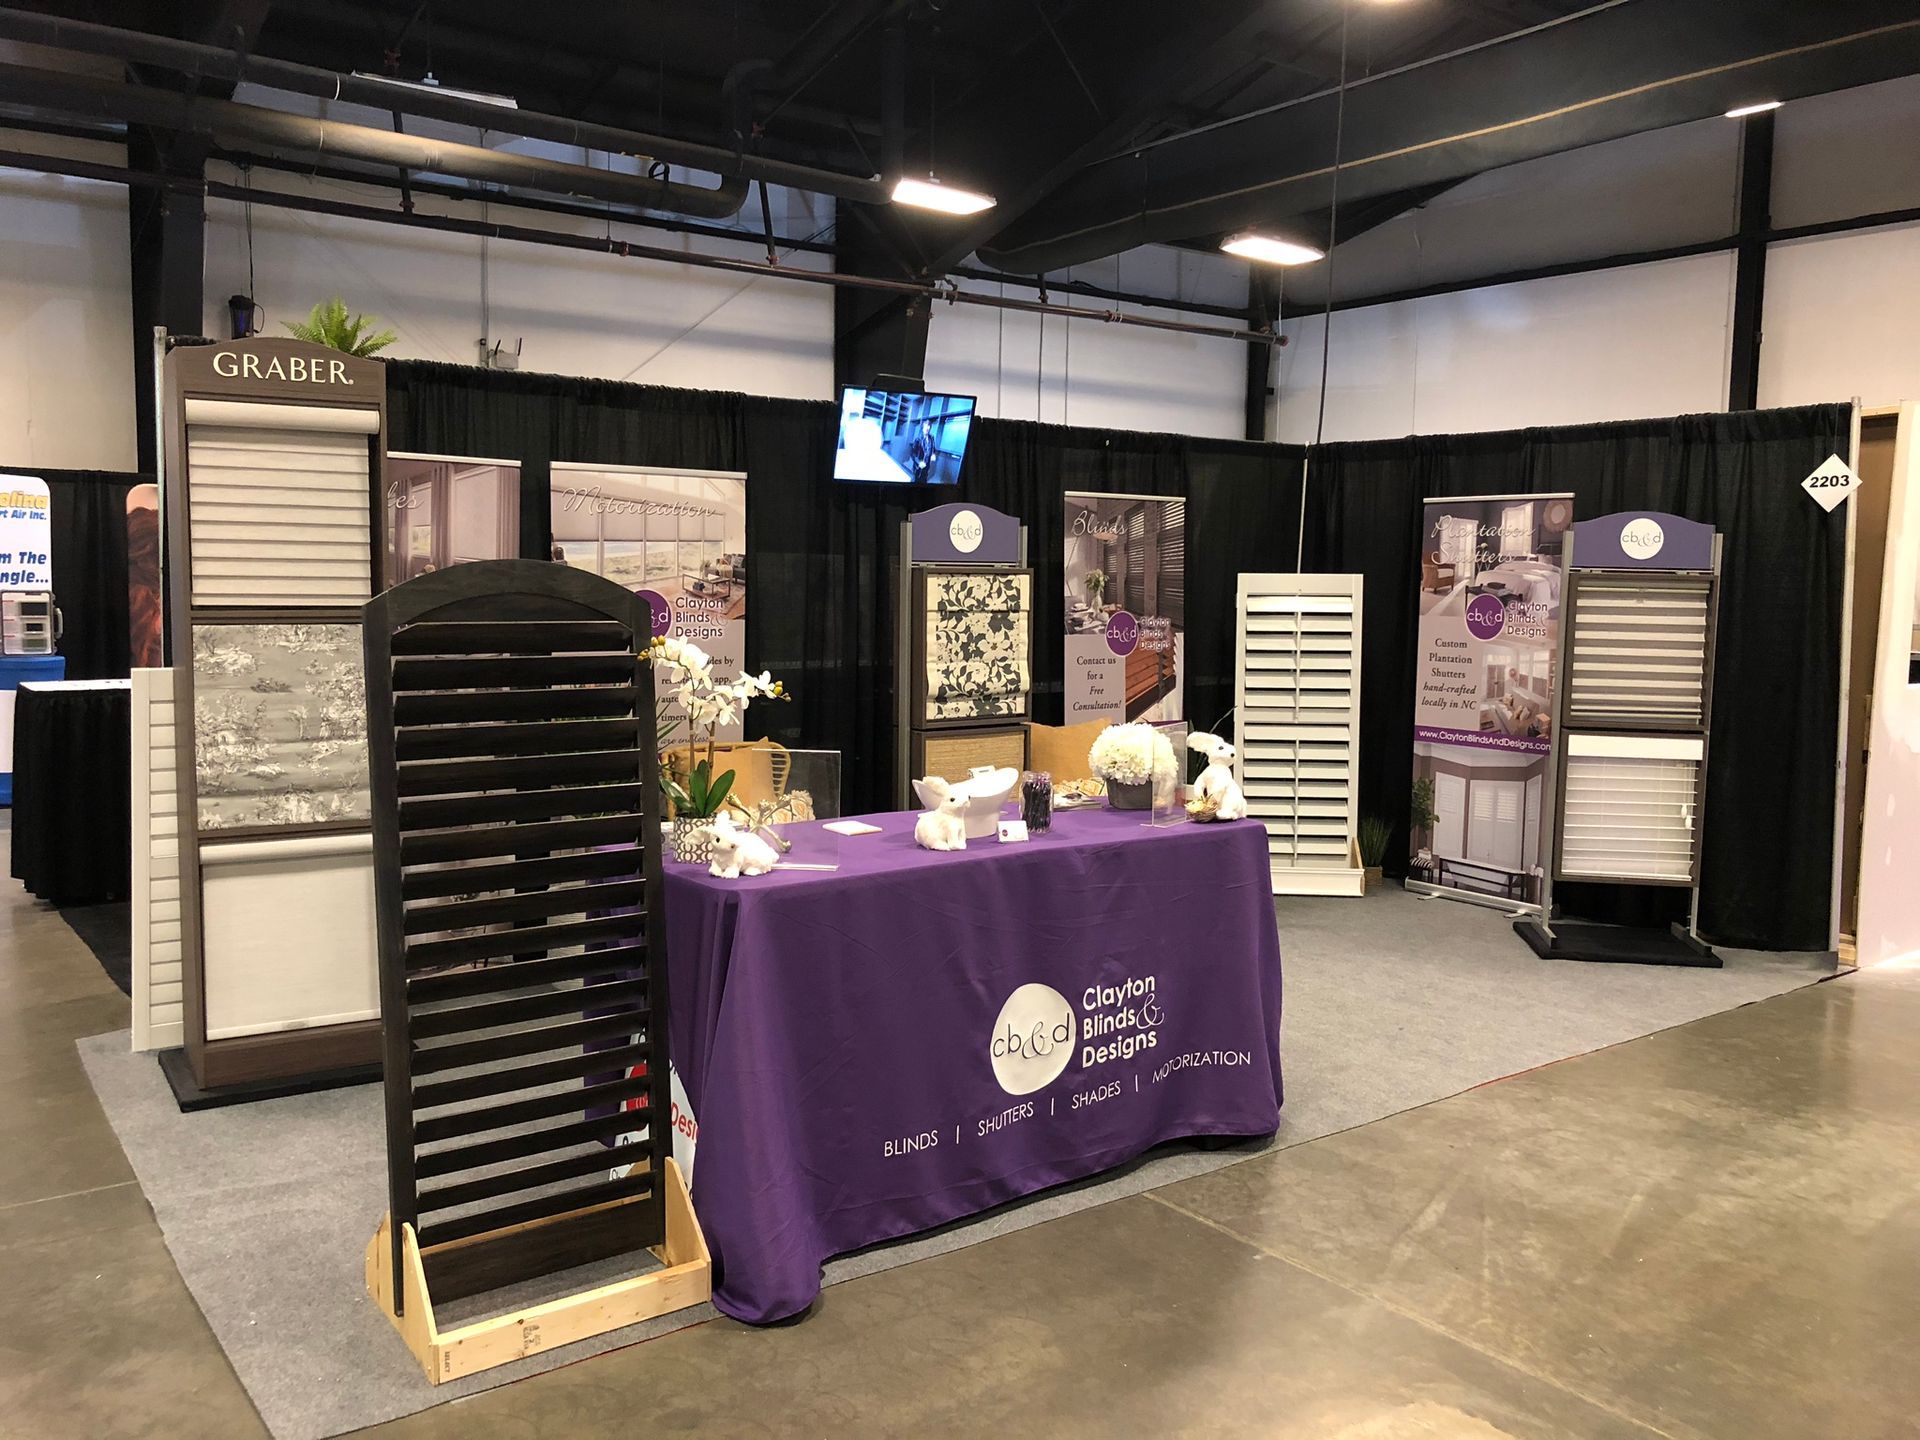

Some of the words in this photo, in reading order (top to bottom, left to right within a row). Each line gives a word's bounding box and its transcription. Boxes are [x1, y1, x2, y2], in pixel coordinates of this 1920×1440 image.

[213, 352, 350, 385] GRABER
[1809, 474, 1850, 488] 2203
[562, 485, 718, 517] Motorization
[11, 510, 26, 519] Air
[30, 510, 47, 520] Inc.
[1071, 510, 1128, 536] Blinds
[1431, 514, 1536, 538] Plantation
[951, 523, 982, 541] cb&d
[1622, 531, 1662, 547] cb&d
[19, 552, 47, 564] The
[1431, 542, 1512, 565] Shutters
[675, 597, 723, 611] Clayton
[1508, 601, 1548, 616] Clayton
[675, 611, 710, 623] Blinds
[1467, 608, 1503, 627] cb&d
[1508, 613, 1536, 624] Blinds
[675, 626, 723, 640] Designs
[1106, 625, 1137, 642] cb&d
[1507, 625, 1546, 638] Designs
[1435, 638, 1468, 649] Custom
[724, 655, 735, 667] by
[1077, 655, 1105, 667] Contact
[1108, 657, 1116, 665] us
[1429, 652, 1473, 665] Plantation
[1087, 670, 1097, 680] for
[1431, 667, 1466, 679] Shutters
[1089, 686, 1104, 695] Free
[1423, 682, 1477, 695] hand-crafted
[1073, 700, 1122, 711] Consultation!
[1421, 696, 1447, 711] locally
[1450, 699, 1458, 708] in
[1461, 701, 1477, 710] NC
[661, 713, 687, 722] timers
[1083, 975, 1155, 1011] Clayton
[993, 1013, 1071, 1060] cb&d
[1082, 1029, 1157, 1069] Designs
[884, 1129, 939, 1158] BLINDS
[977, 1101, 1034, 1137] SHUTTERS
[1071, 1080, 1121, 1110] SHADES
[1152, 1051, 1251, 1084] MOTORIZATION
